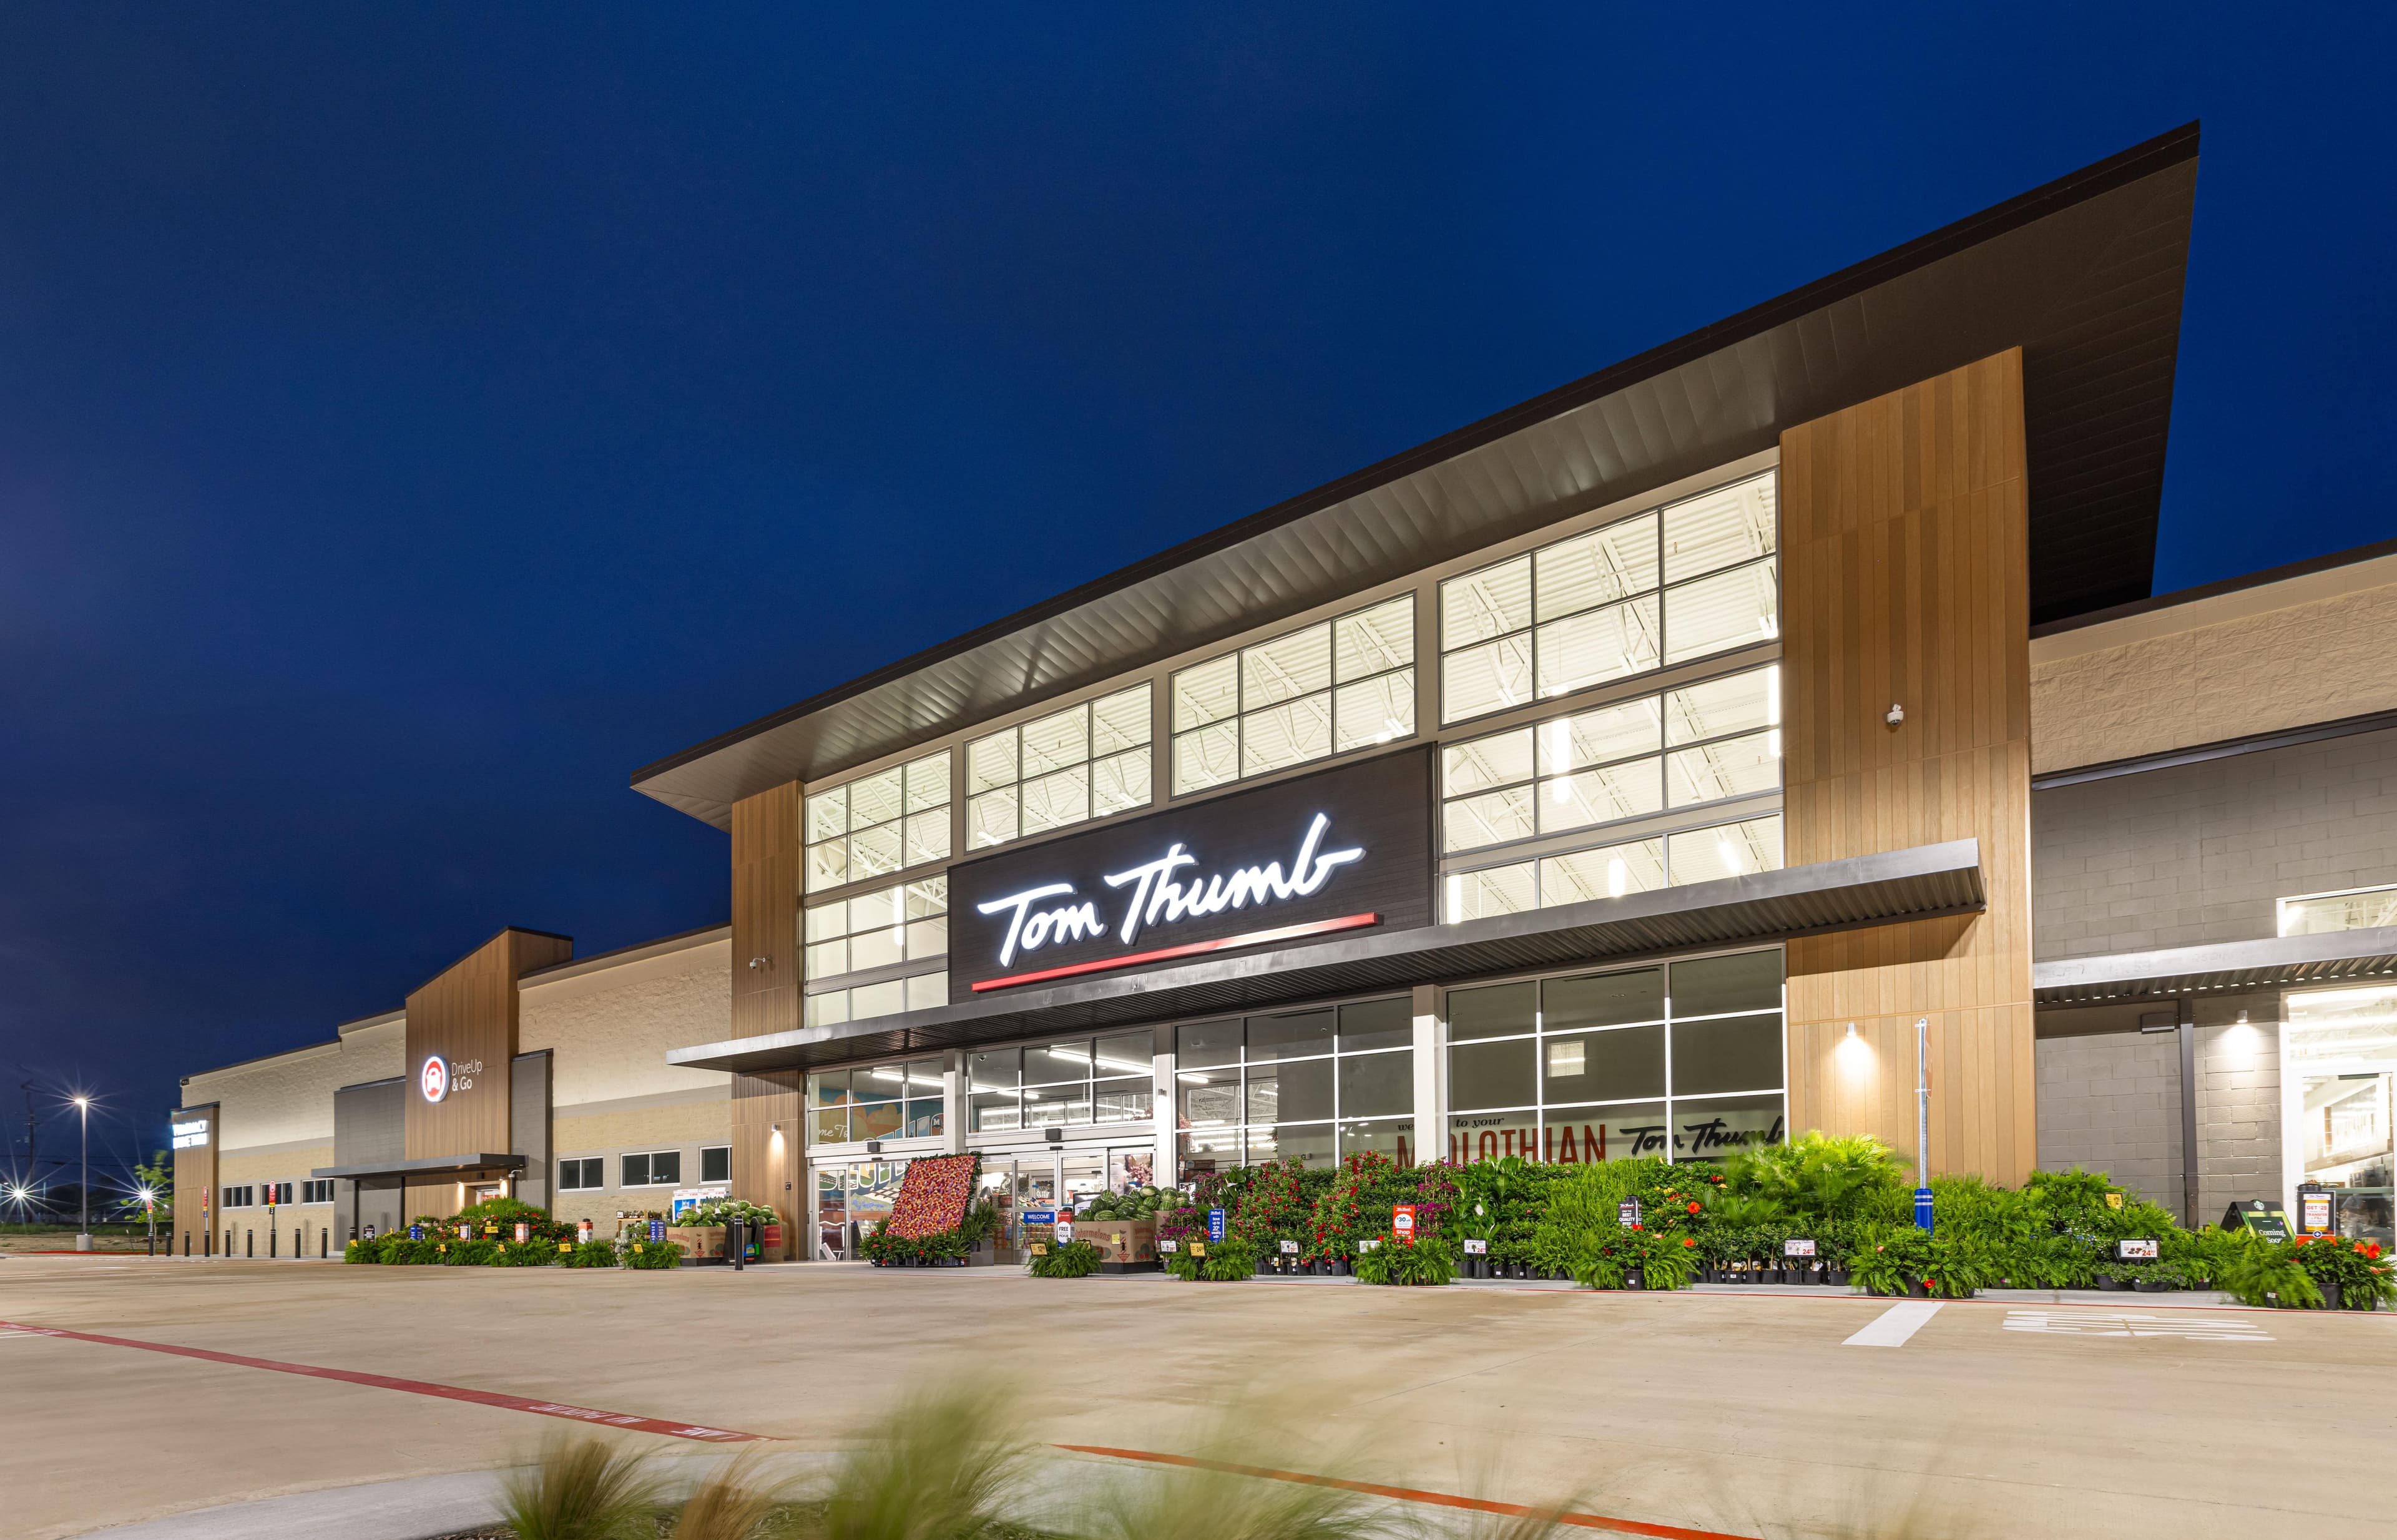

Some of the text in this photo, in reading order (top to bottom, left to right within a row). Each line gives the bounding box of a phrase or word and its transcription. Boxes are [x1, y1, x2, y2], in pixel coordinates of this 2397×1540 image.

[977, 813, 1365, 968] Tom Thumb
[452, 1059, 483, 1076] DriveUp
[452, 1076, 473, 1091] & Go
[1456, 1117, 1504, 1128] to your
[1619, 1115, 1784, 1156] Tom Thumb
[2002, 1310, 2277, 1341] STOP
